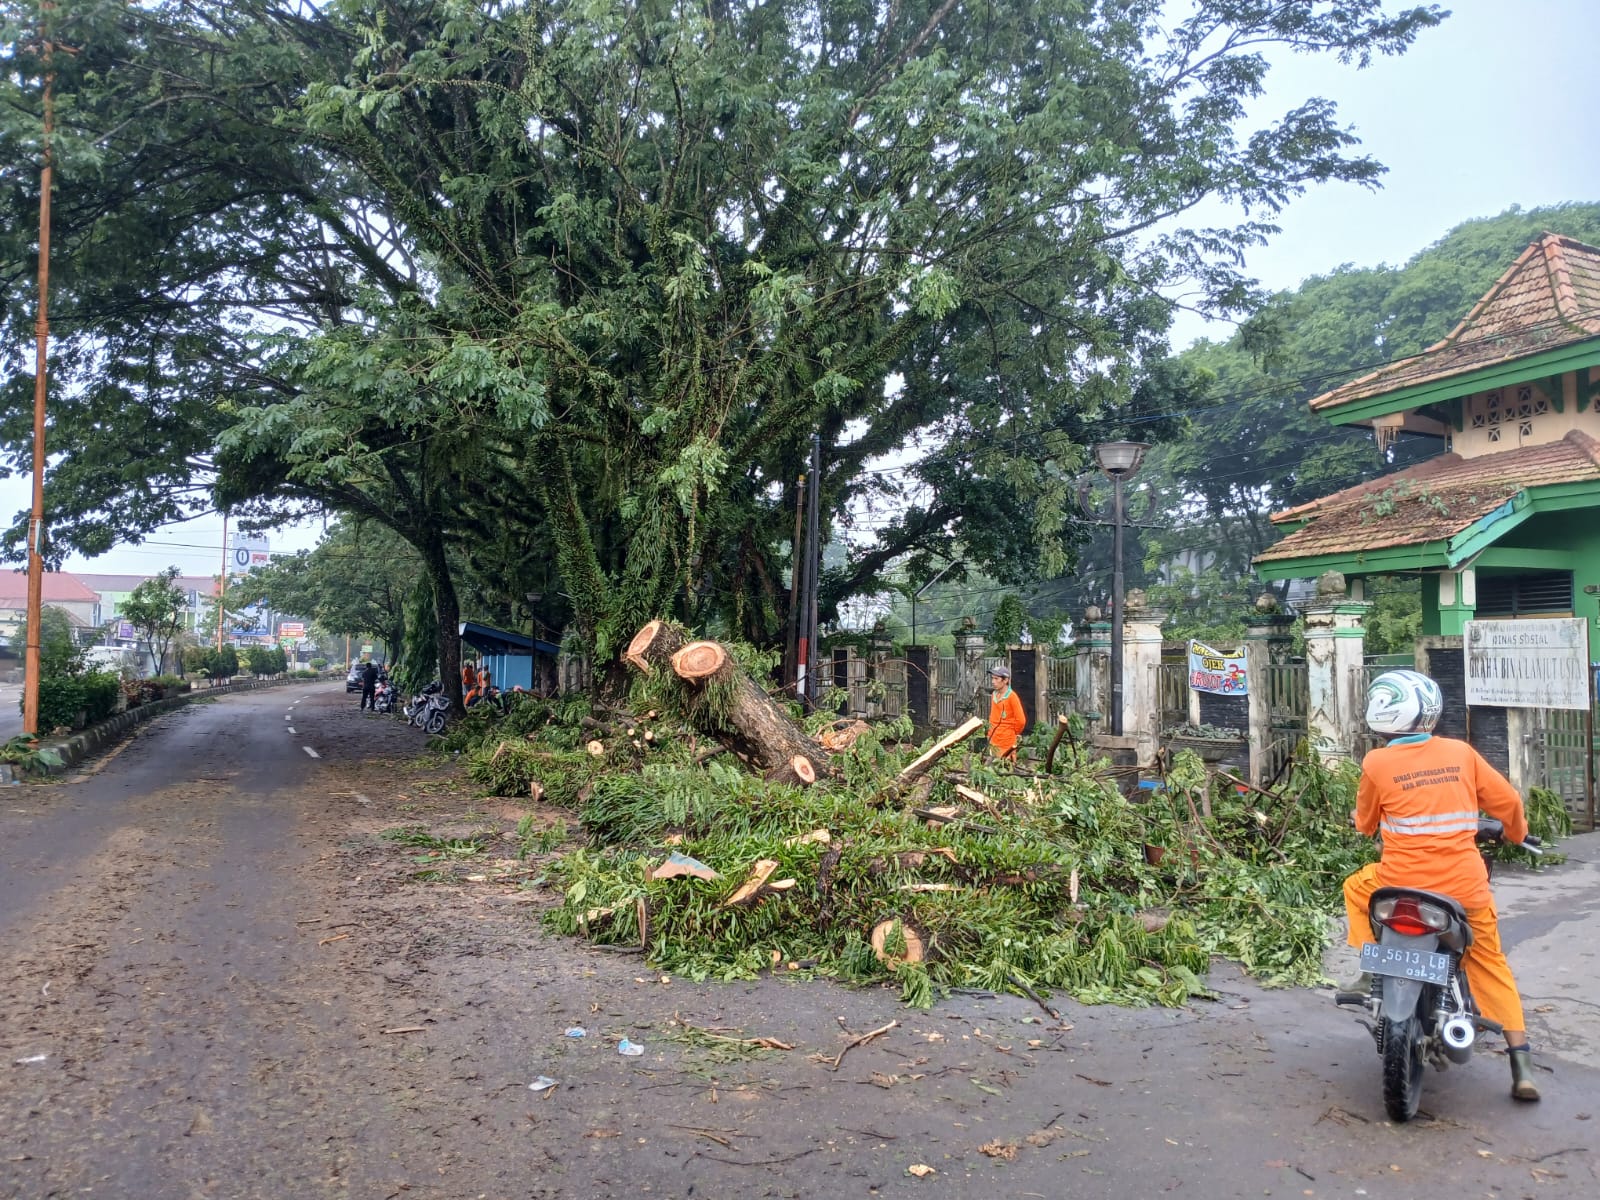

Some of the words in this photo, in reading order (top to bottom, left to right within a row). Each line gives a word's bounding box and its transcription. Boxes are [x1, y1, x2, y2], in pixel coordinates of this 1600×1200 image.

[1492, 634, 1517, 645] DINAS
[1519, 633, 1549, 645] SOSIAL
[1203, 658, 1225, 671] OJEK
[1393, 773, 1411, 784] DINAS
[1386, 948, 1420, 964] 5613
[1429, 955, 1446, 969] LB
